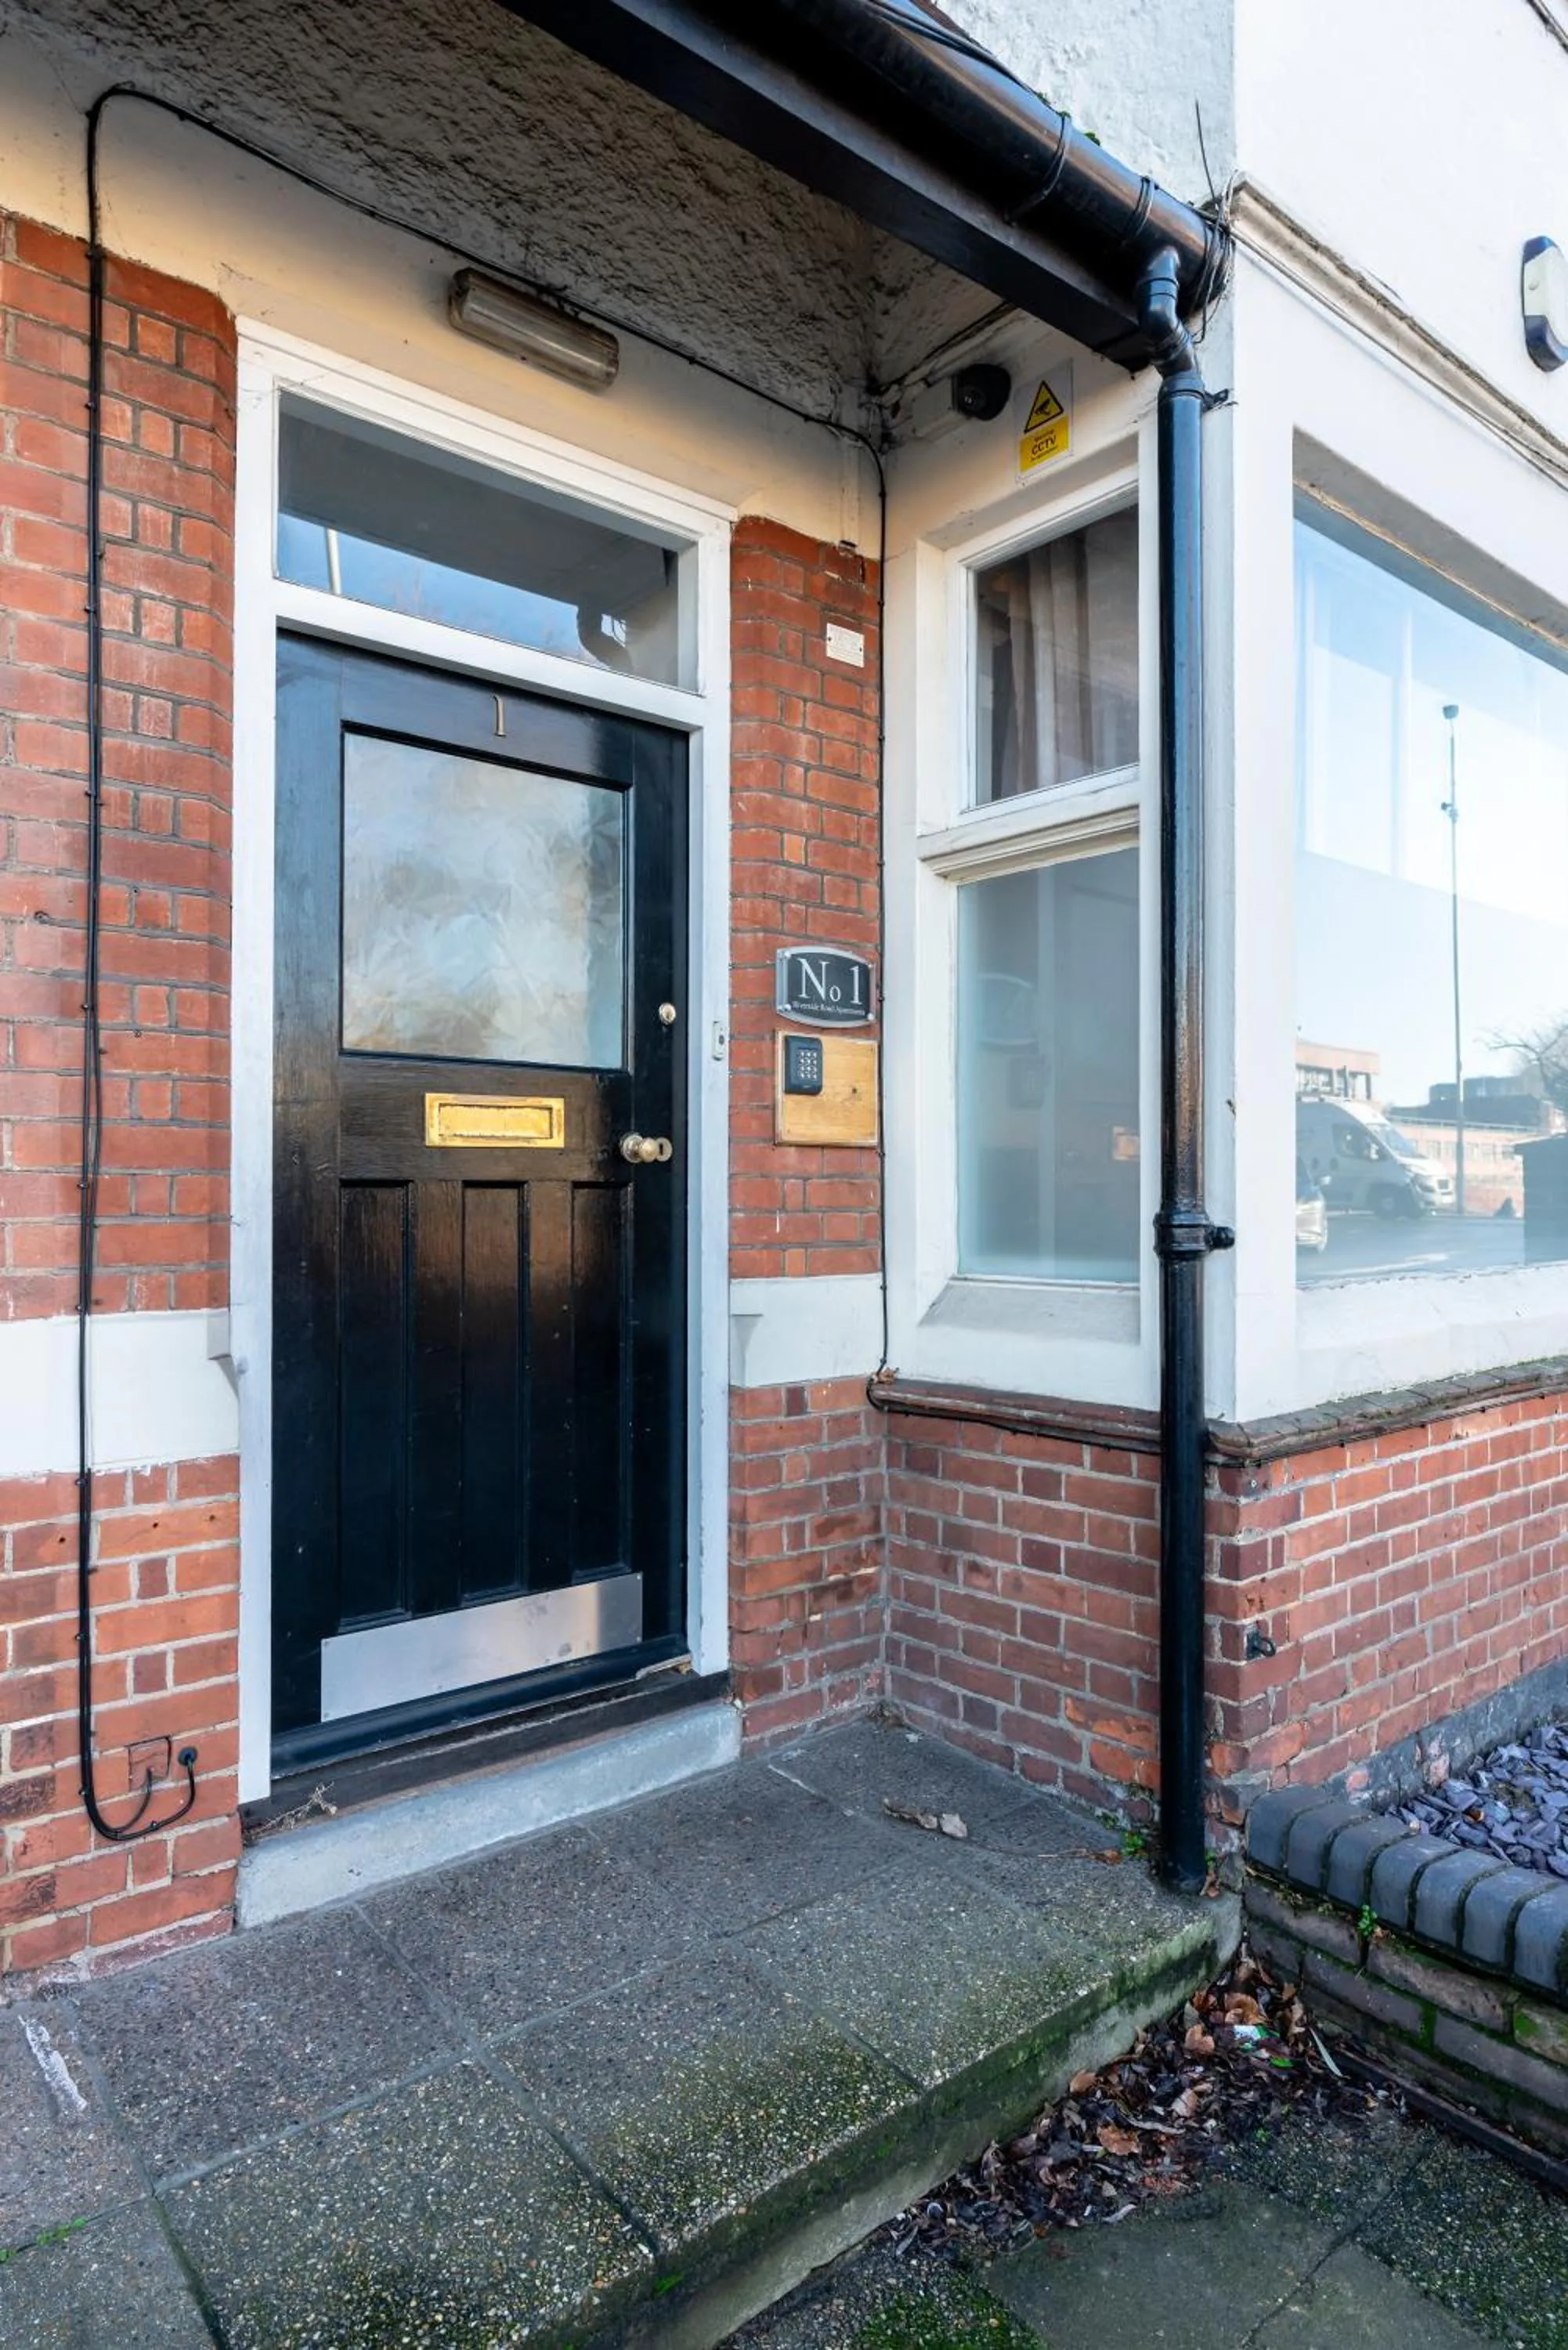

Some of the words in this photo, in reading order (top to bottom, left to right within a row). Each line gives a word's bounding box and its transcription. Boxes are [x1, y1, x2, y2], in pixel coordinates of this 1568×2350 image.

[1031, 435, 1057, 455] CCTV
[493, 693, 507, 737] 1
[796, 957, 841, 1002] No
[850, 965, 863, 1005] 1
